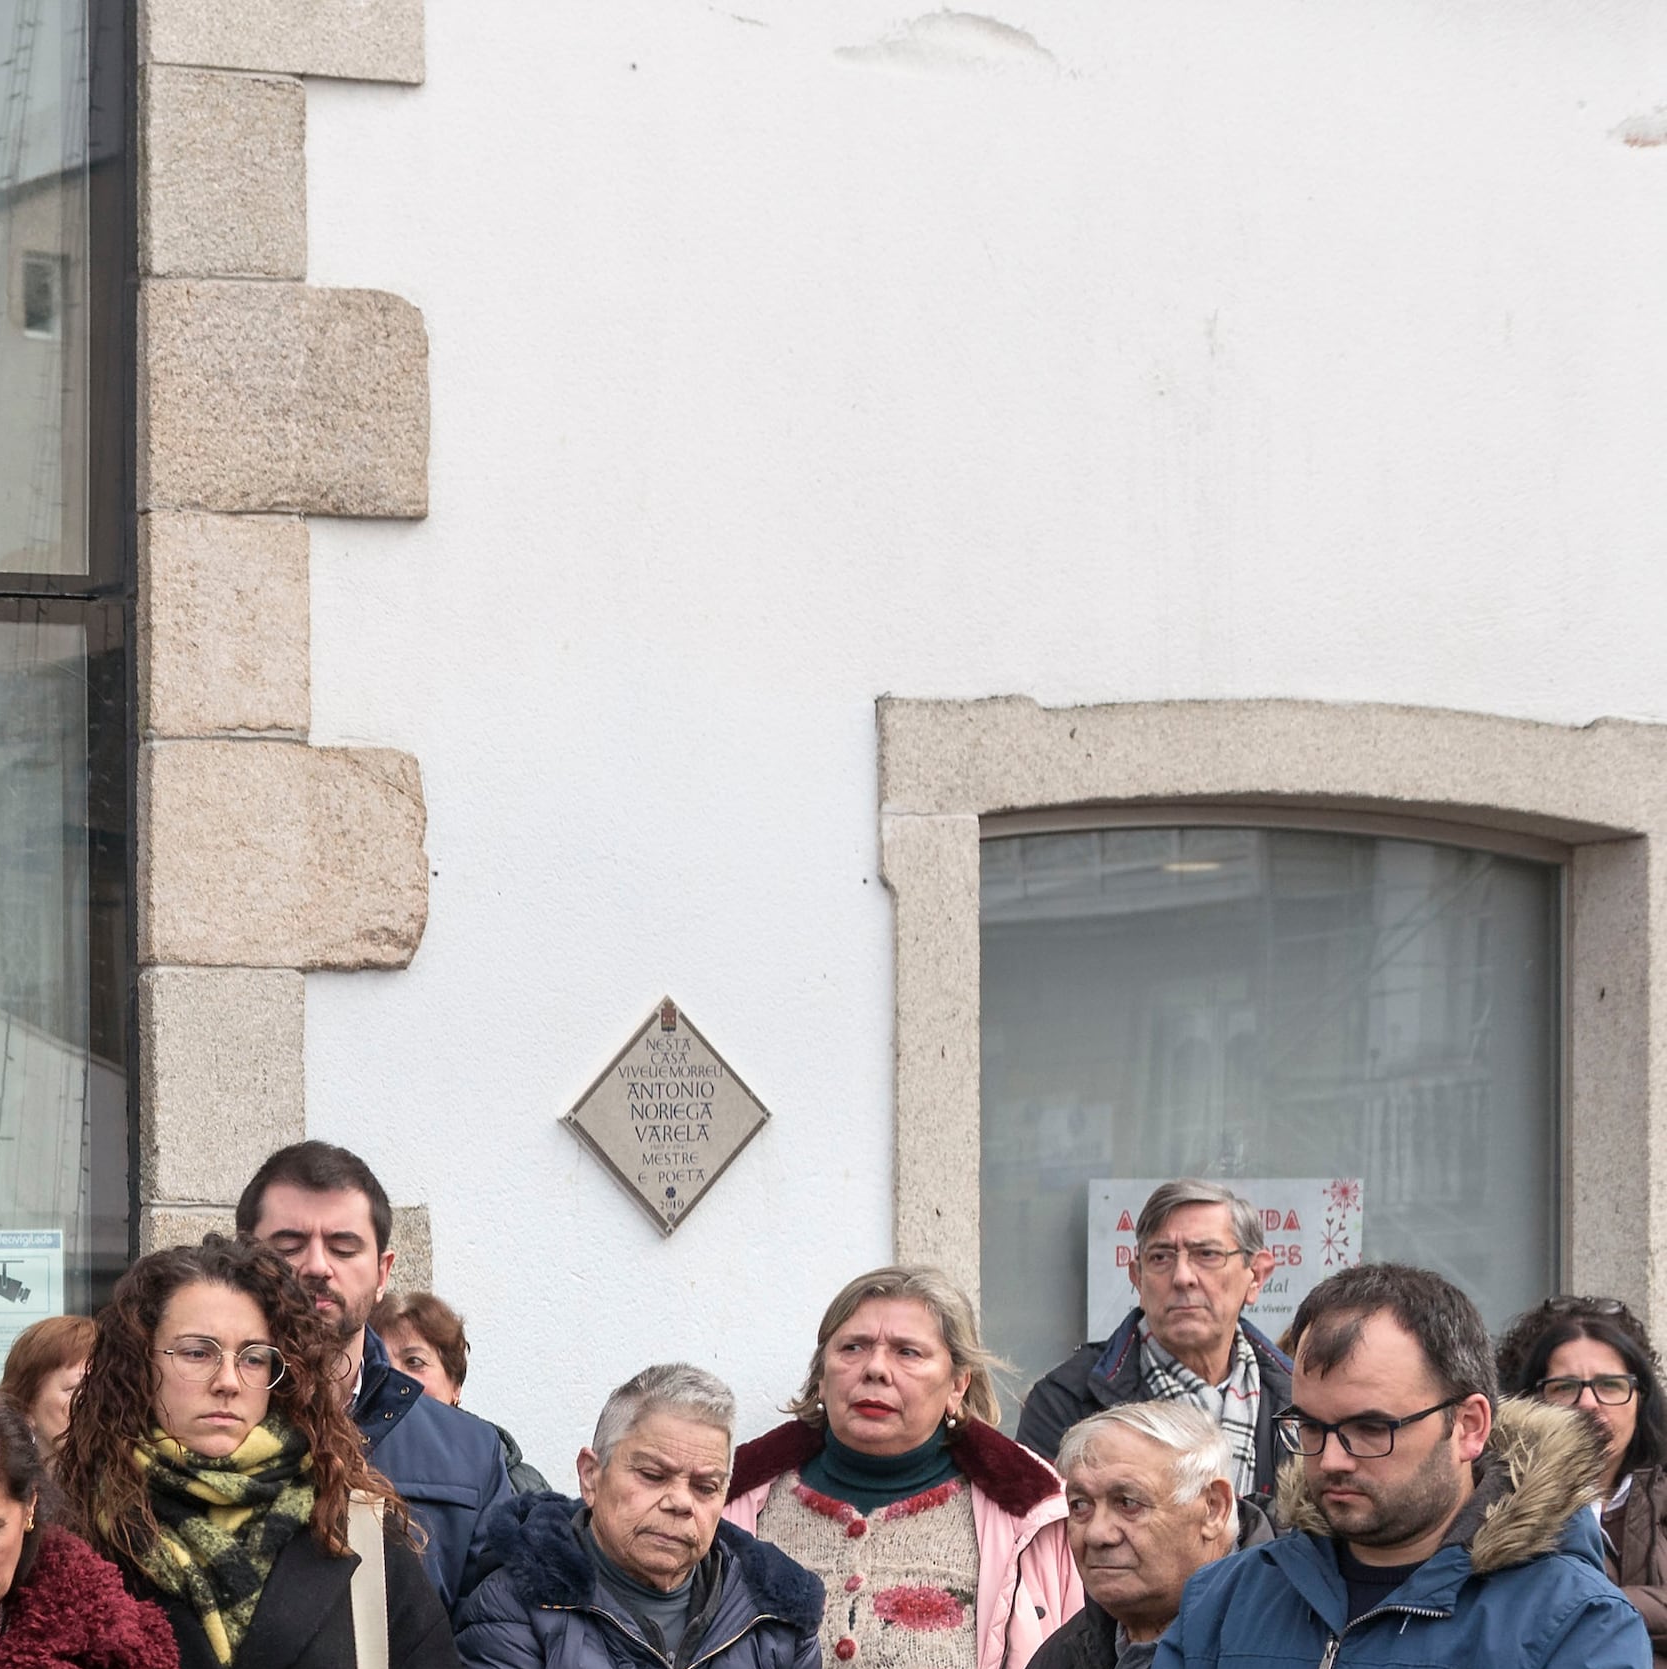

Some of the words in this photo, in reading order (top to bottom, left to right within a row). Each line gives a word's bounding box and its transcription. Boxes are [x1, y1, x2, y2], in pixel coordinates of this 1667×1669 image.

[646, 1038, 691, 1051] NESTA
[650, 1052, 688, 1065] CASA
[627, 1081, 715, 1100] ANTONIO
[631, 1102, 713, 1121] NORIEGA
[635, 1124, 709, 1143] VARELA
[642, 1152, 699, 1166] MESTRE
[638, 1171, 647, 1184] E
[658, 1168, 705, 1183] POETA
[1116, 1209, 1135, 1231] A
[1261, 1303, 1293, 1313] Viveiro
